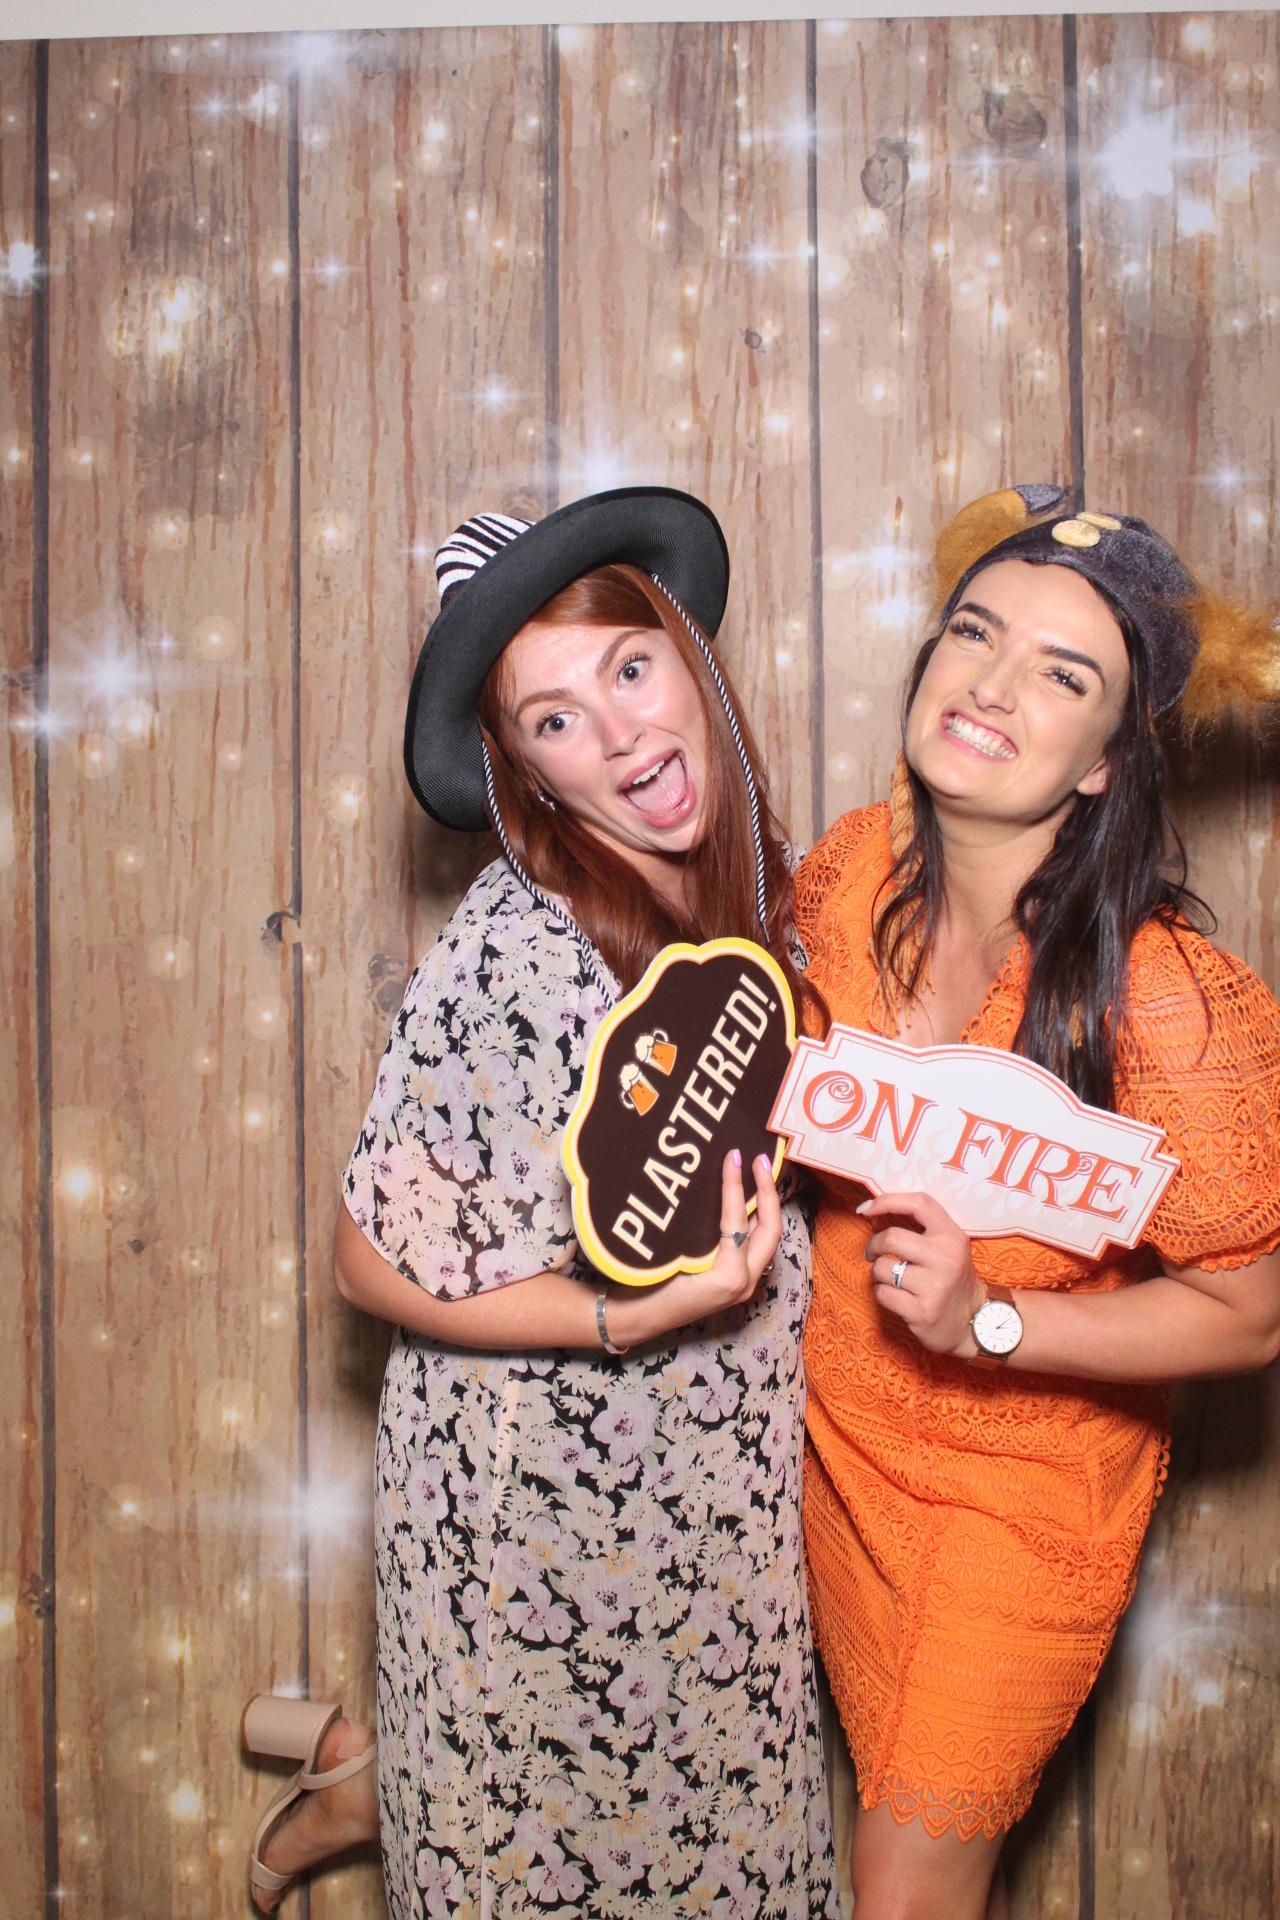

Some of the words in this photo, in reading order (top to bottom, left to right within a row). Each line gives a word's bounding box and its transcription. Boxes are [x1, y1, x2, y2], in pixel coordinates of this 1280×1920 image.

[611, 973, 778, 1262] PLASTERED!
[802, 1069, 939, 1156] ON
[940, 1106, 1142, 1223] FIRE
